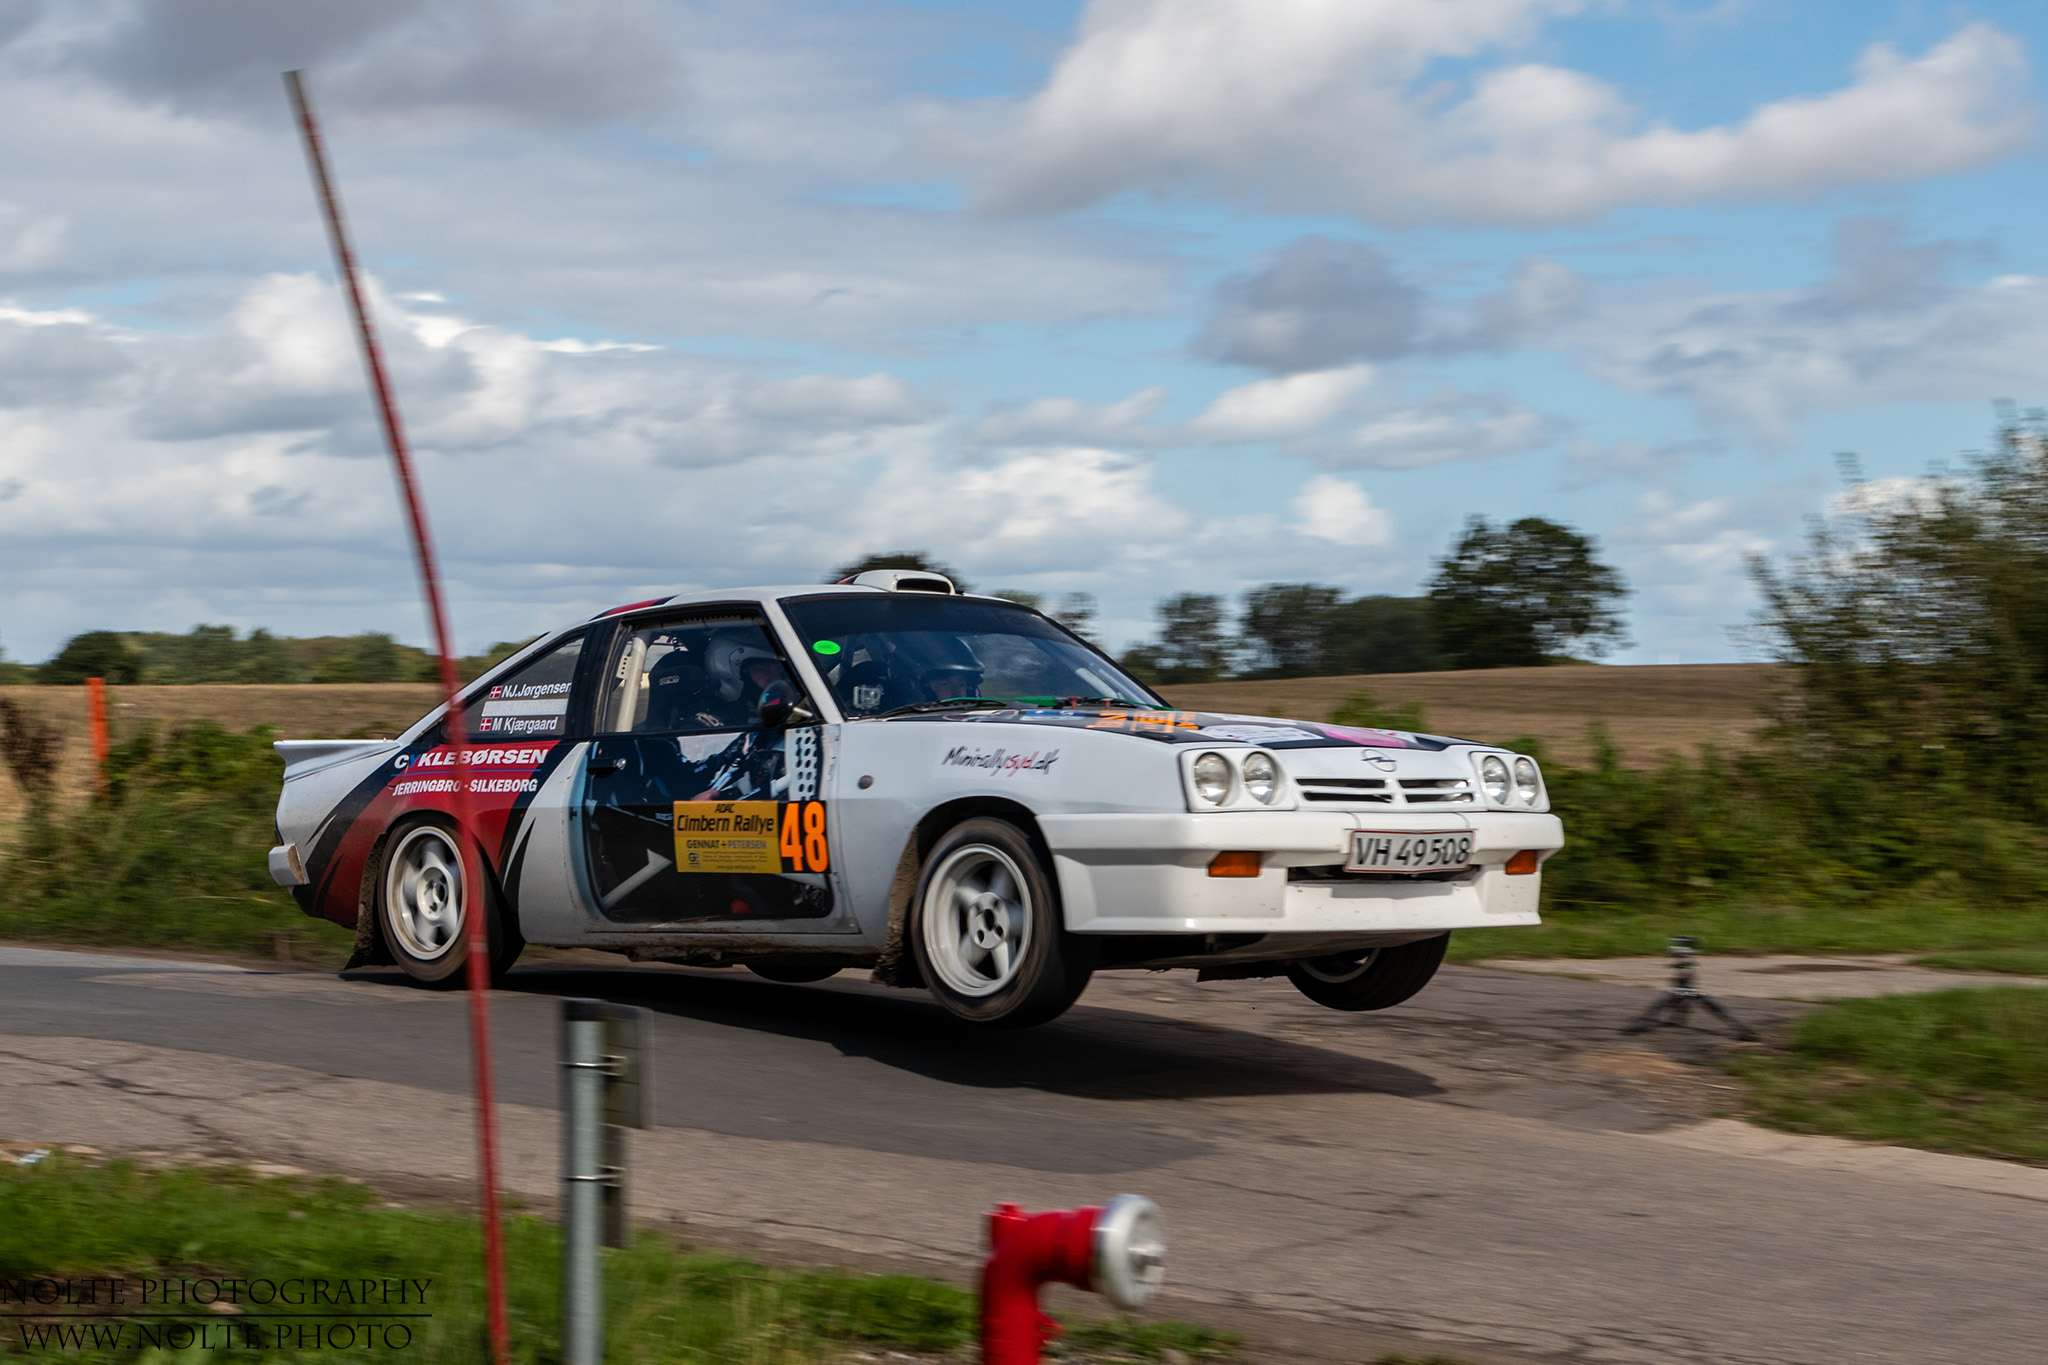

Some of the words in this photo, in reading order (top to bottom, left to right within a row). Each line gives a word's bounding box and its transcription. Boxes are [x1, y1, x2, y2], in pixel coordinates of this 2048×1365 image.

[491, 717, 503, 731] M
[503, 716, 558, 734] Kjærgaard
[394, 748, 549, 769] CYKLEBØRSEN
[469, 778, 538, 793] SILKEBORG
[714, 803, 735, 813] ADAC
[677, 815, 730, 832] Cimbern
[733, 815, 775, 835] Rallye
[686, 840, 720, 849] GENNAT
[727, 840, 767, 849] PETERSEN
[780, 801, 829, 873] 48
[1356, 838, 1392, 866] VH
